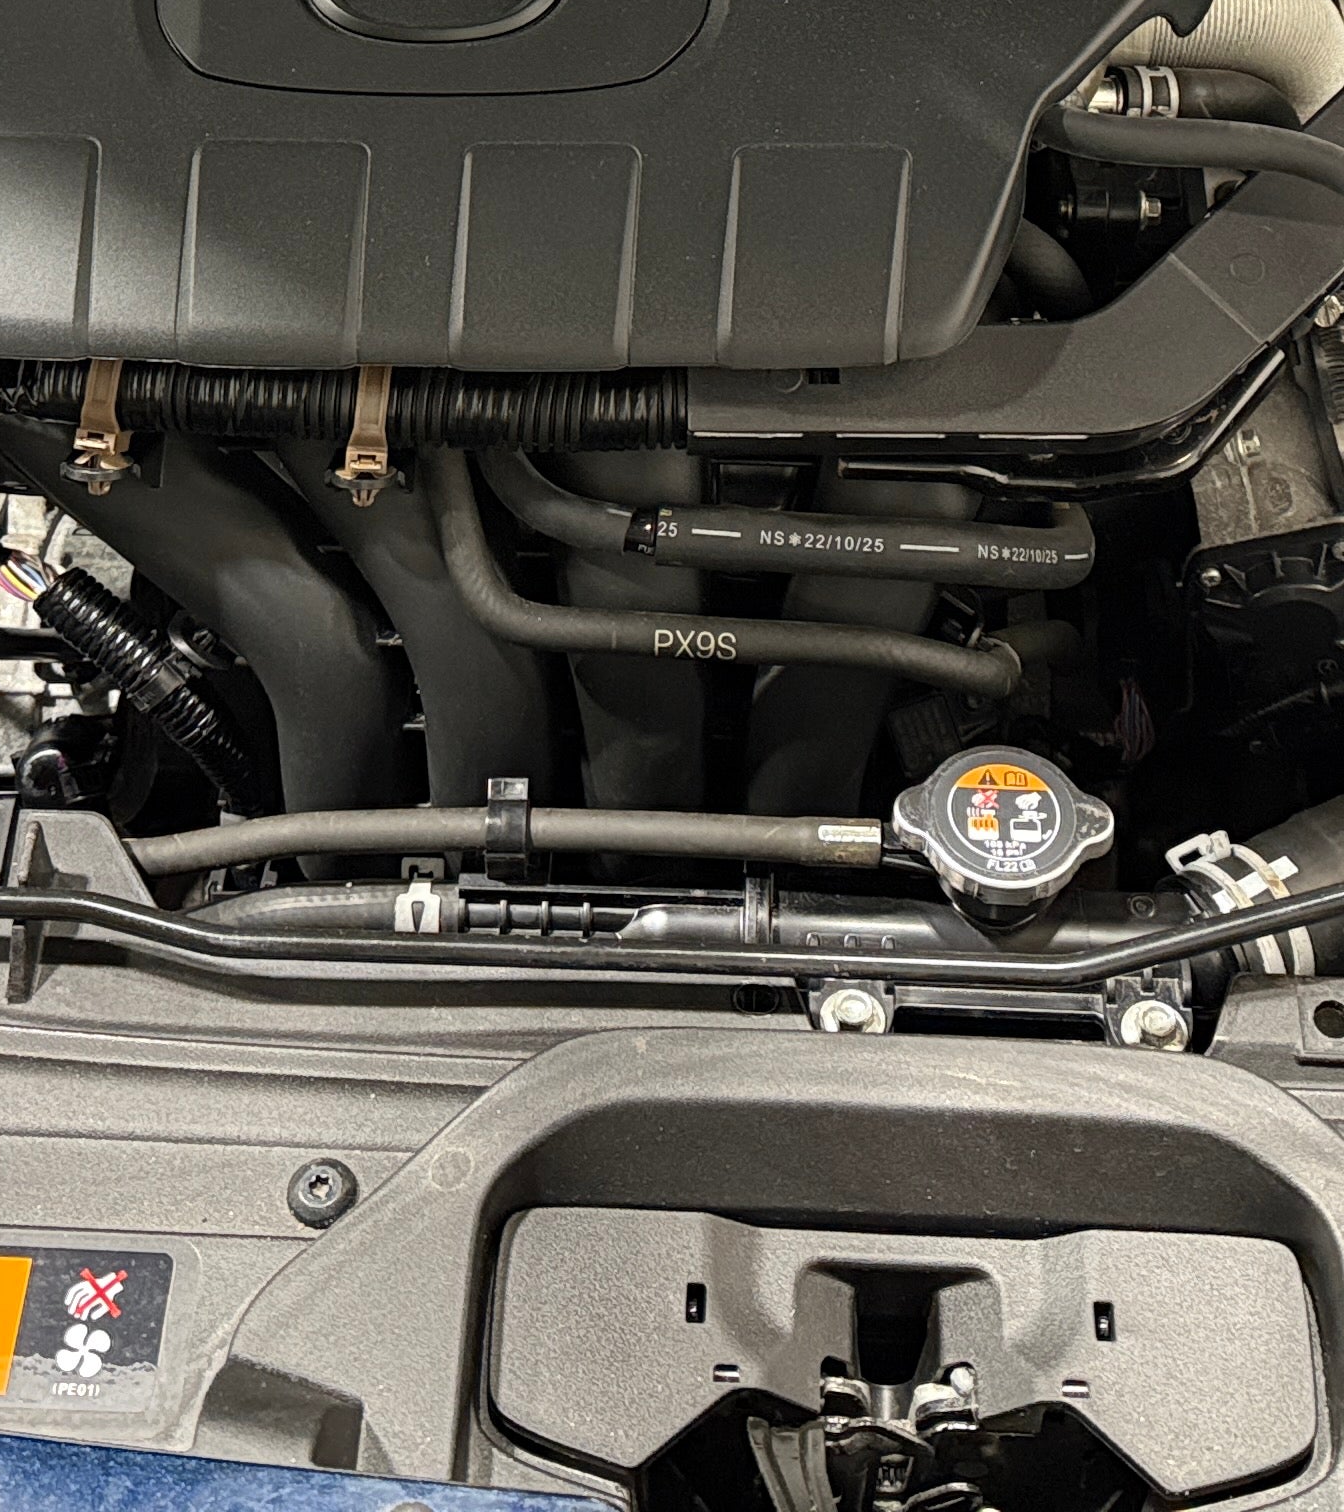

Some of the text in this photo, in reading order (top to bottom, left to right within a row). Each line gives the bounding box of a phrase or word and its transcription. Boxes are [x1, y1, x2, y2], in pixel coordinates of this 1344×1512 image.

[653, 628, 738, 660] PX9S
[986, 858, 1019, 873] FL22
[52, 1382, 101, 1397] (PE01)
